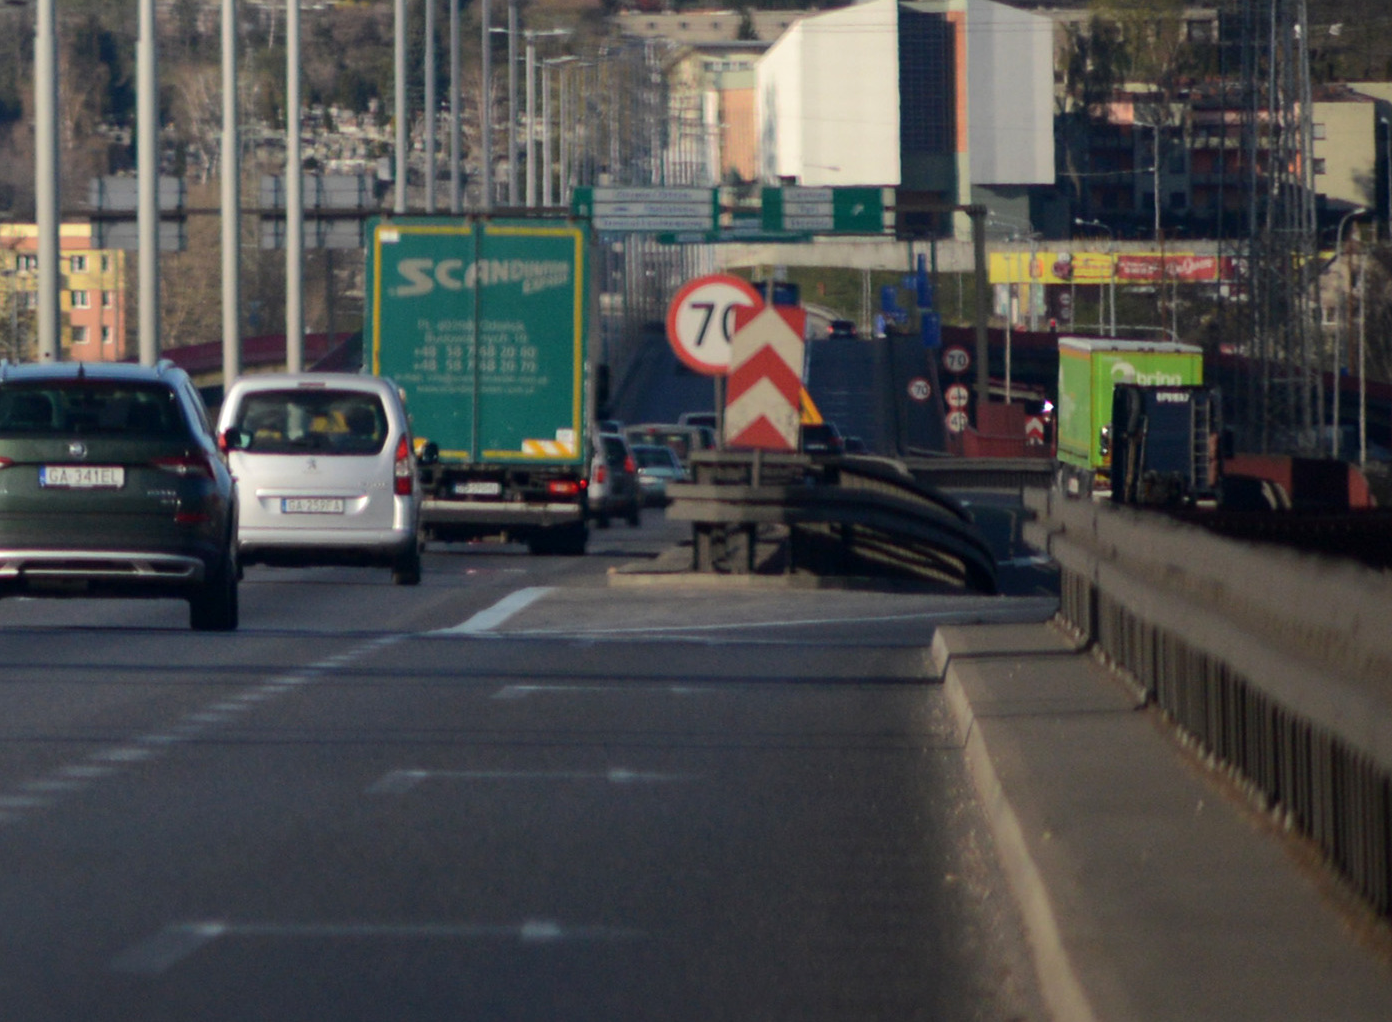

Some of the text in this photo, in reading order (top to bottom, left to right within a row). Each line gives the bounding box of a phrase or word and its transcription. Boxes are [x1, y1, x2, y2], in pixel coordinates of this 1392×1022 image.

[948, 354, 967, 367] 70
[915, 384, 929, 395] 70
[49, 469, 70, 484] GA
